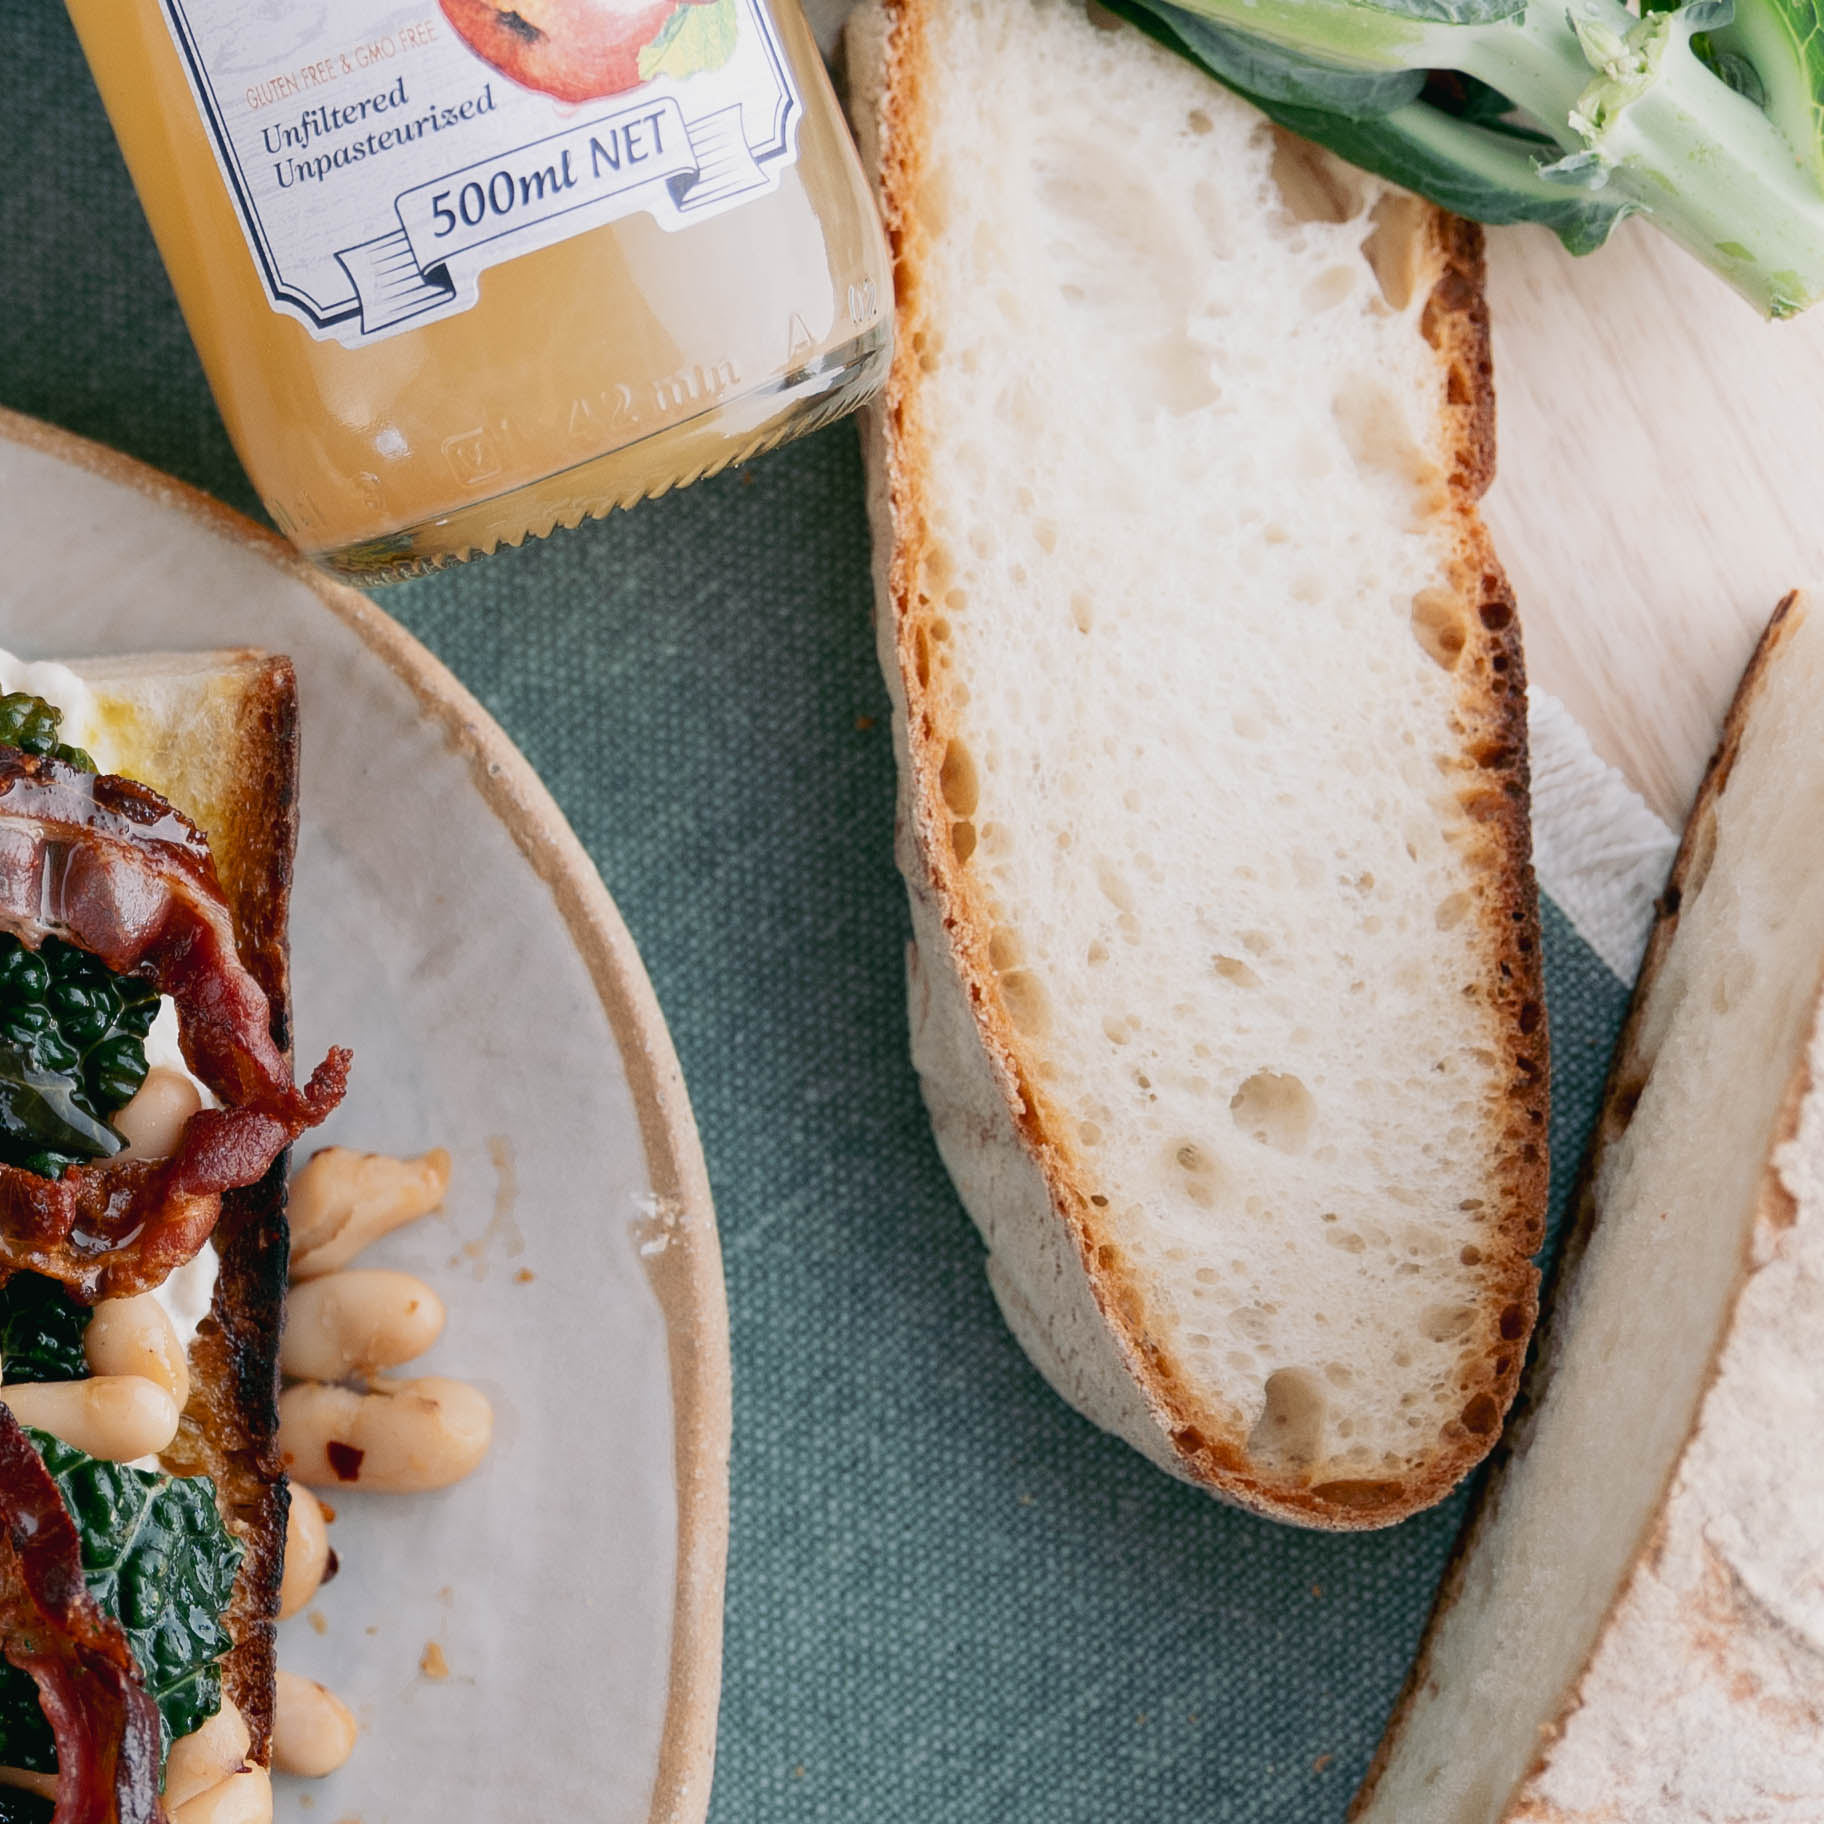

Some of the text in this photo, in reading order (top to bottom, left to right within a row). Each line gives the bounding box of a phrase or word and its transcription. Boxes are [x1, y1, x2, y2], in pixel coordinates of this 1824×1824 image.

[246, 20, 439, 111] GLUTEN FREE & GMO FREE
[261, 76, 409, 154] Unfiltered
[273, 83, 497, 188] Unpasteurized
[432, 109, 667, 238] 500ml NET
